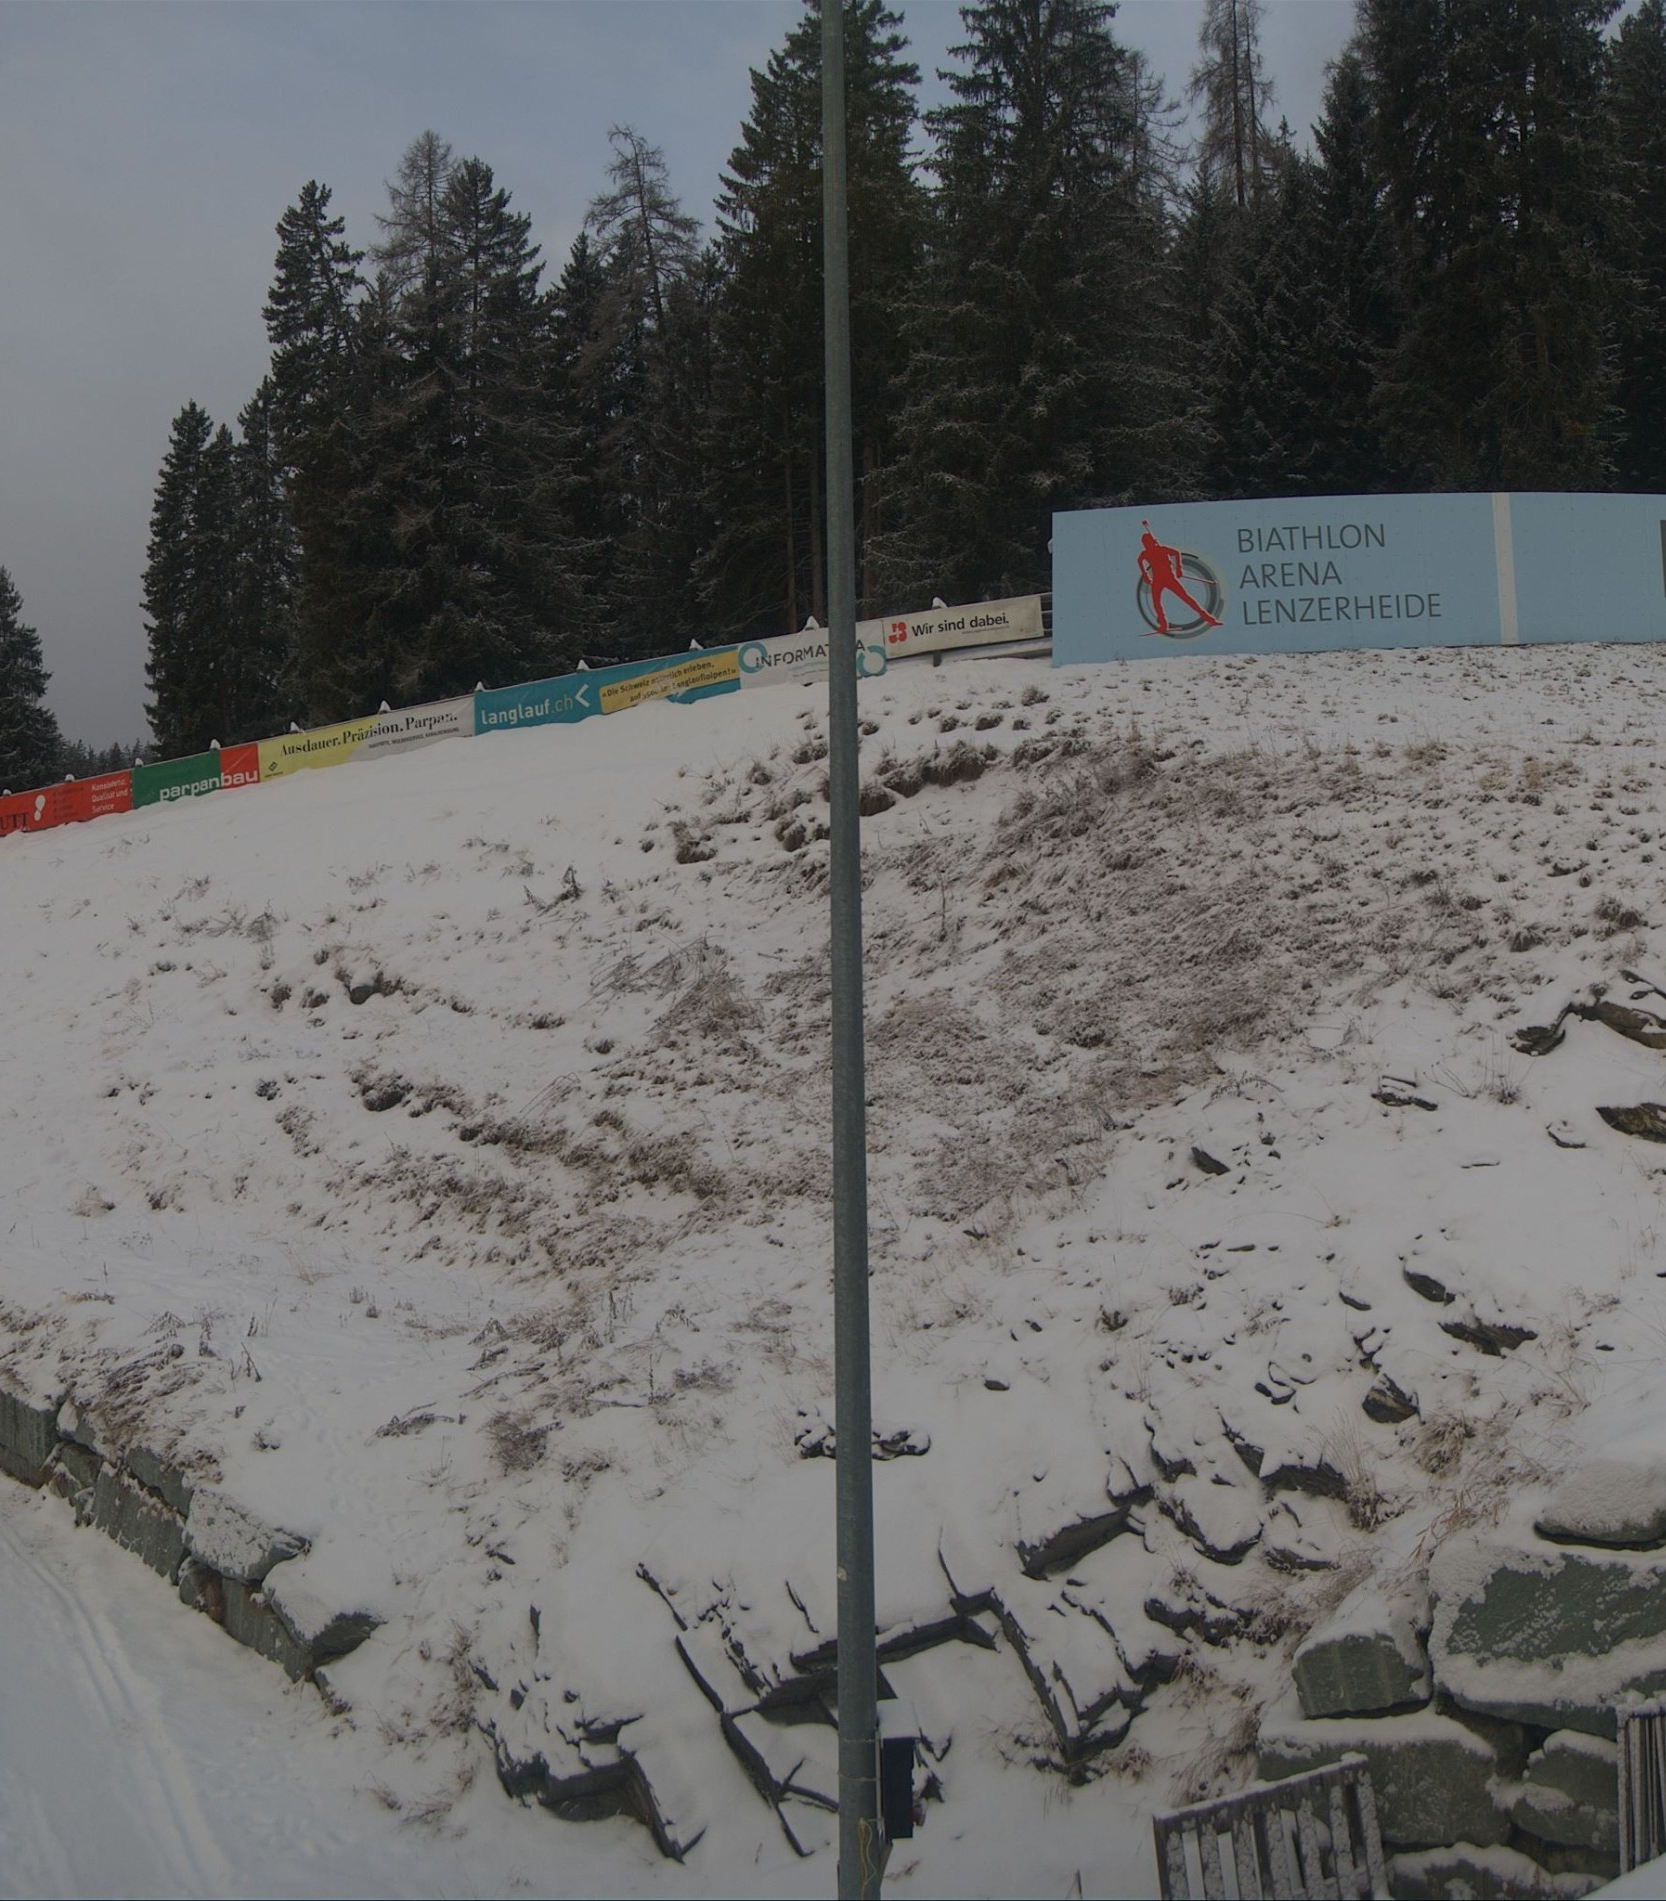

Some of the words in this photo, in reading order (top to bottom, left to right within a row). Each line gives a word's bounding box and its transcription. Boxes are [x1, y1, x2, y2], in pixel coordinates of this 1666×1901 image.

[1237, 522, 1387, 554] BIATHLON
[1239, 559, 1343, 590] ARENA
[911, 622, 934, 638] Wir
[938, 617, 965, 633] sind
[969, 612, 1010, 630] dabei.
[1241, 592, 1443, 627] LENZERHEIDE
[620, 680, 650, 693] Schweiz
[683, 661, 715, 675] erleben,
[481, 697, 573, 726] langlauf.ch
[280, 735, 341, 757] Ausdauer.
[342, 721, 404, 745] Präzision.
[91, 790, 115, 803] Qualität
[116, 788, 128, 798] und
[159, 768, 259, 802] parpanbau
[91, 803, 114, 814] Service
